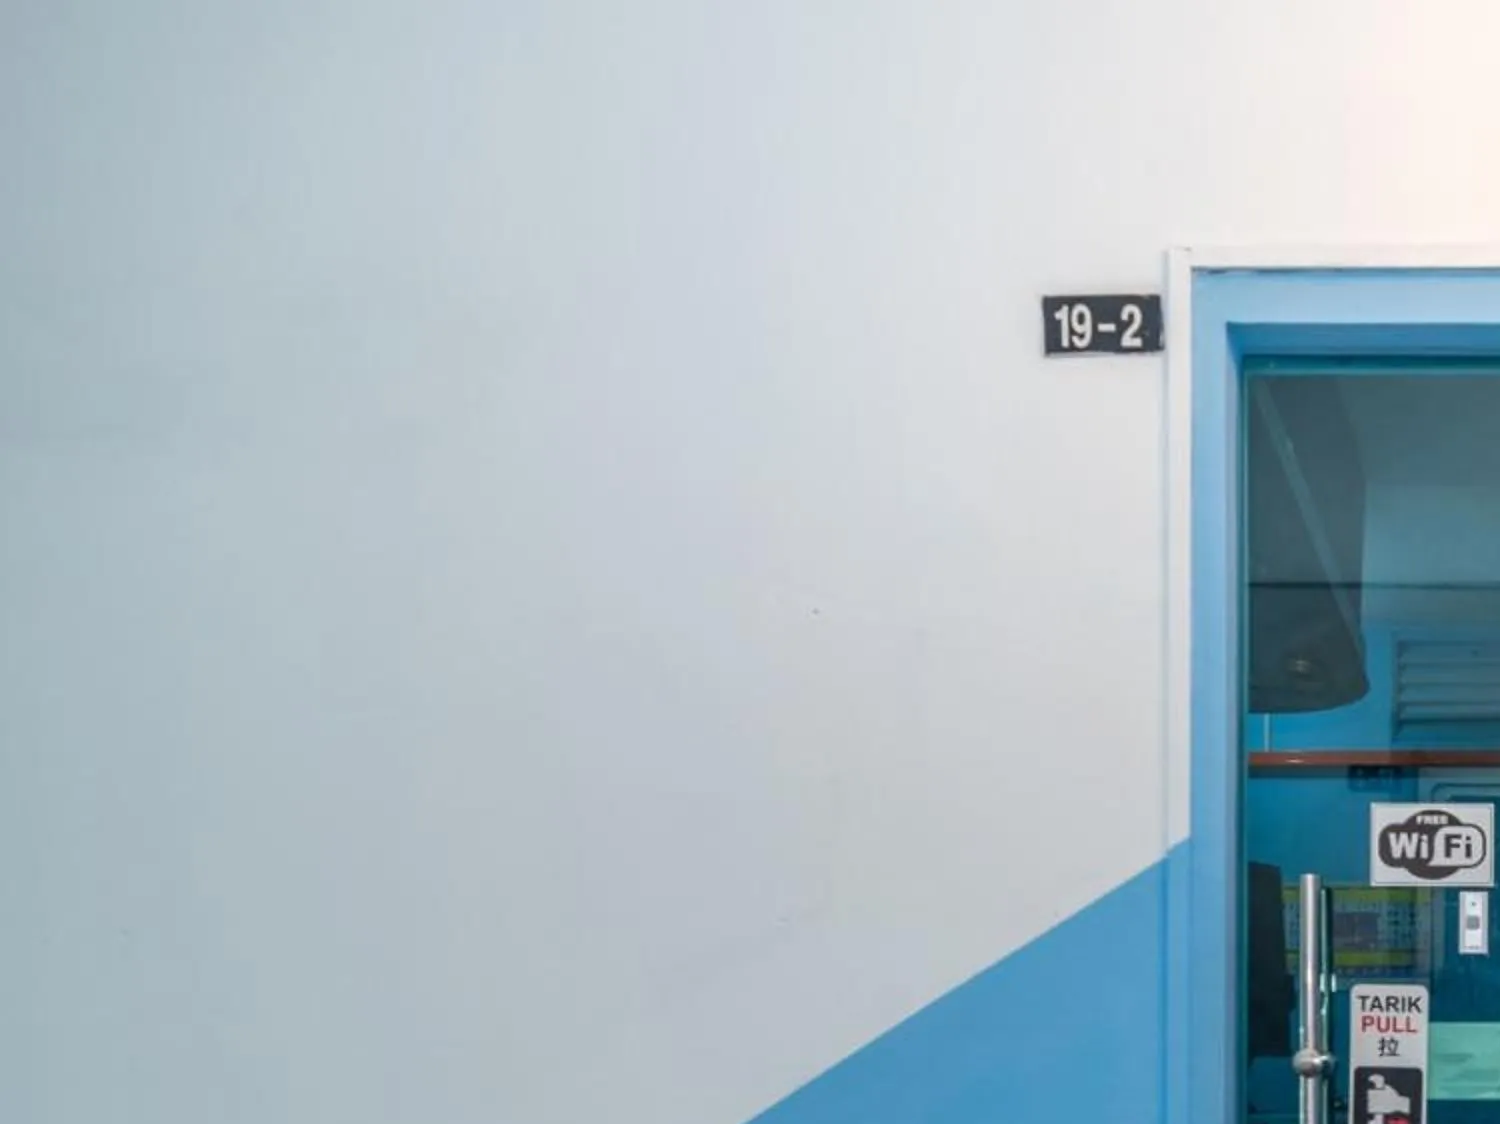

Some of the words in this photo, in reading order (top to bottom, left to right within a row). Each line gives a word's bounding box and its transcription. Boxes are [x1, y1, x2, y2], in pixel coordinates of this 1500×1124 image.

[1054, 303, 1142, 348] 19-2
[1416, 816, 1448, 824] FREE
[1358, 995, 1422, 1013] TARIK
[1361, 1015, 1417, 1033] PULL
[1378, 1037, 1400, 1057] 拉
